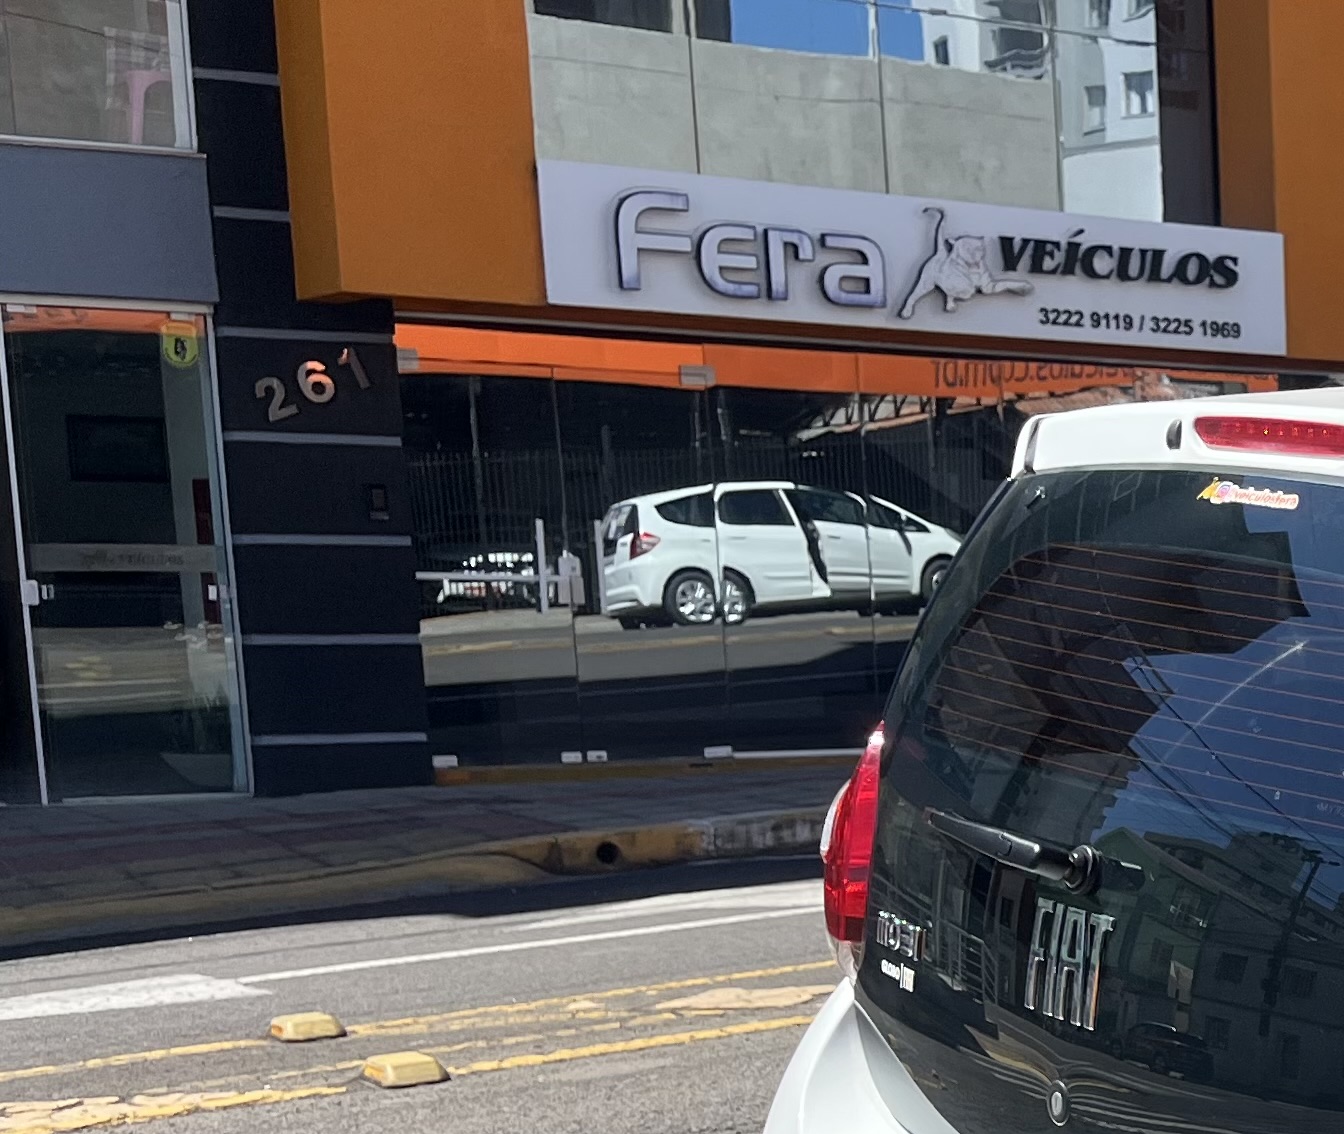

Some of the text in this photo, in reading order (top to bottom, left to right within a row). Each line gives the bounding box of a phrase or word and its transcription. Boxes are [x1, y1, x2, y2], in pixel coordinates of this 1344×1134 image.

[614, 189, 1240, 309] Fera VEÍCULOS
[1038, 306, 1242, 340] 3222 9119 / 3225 1969
[254, 346, 372, 424] 261
[1024, 896, 1116, 1032] FIAT
